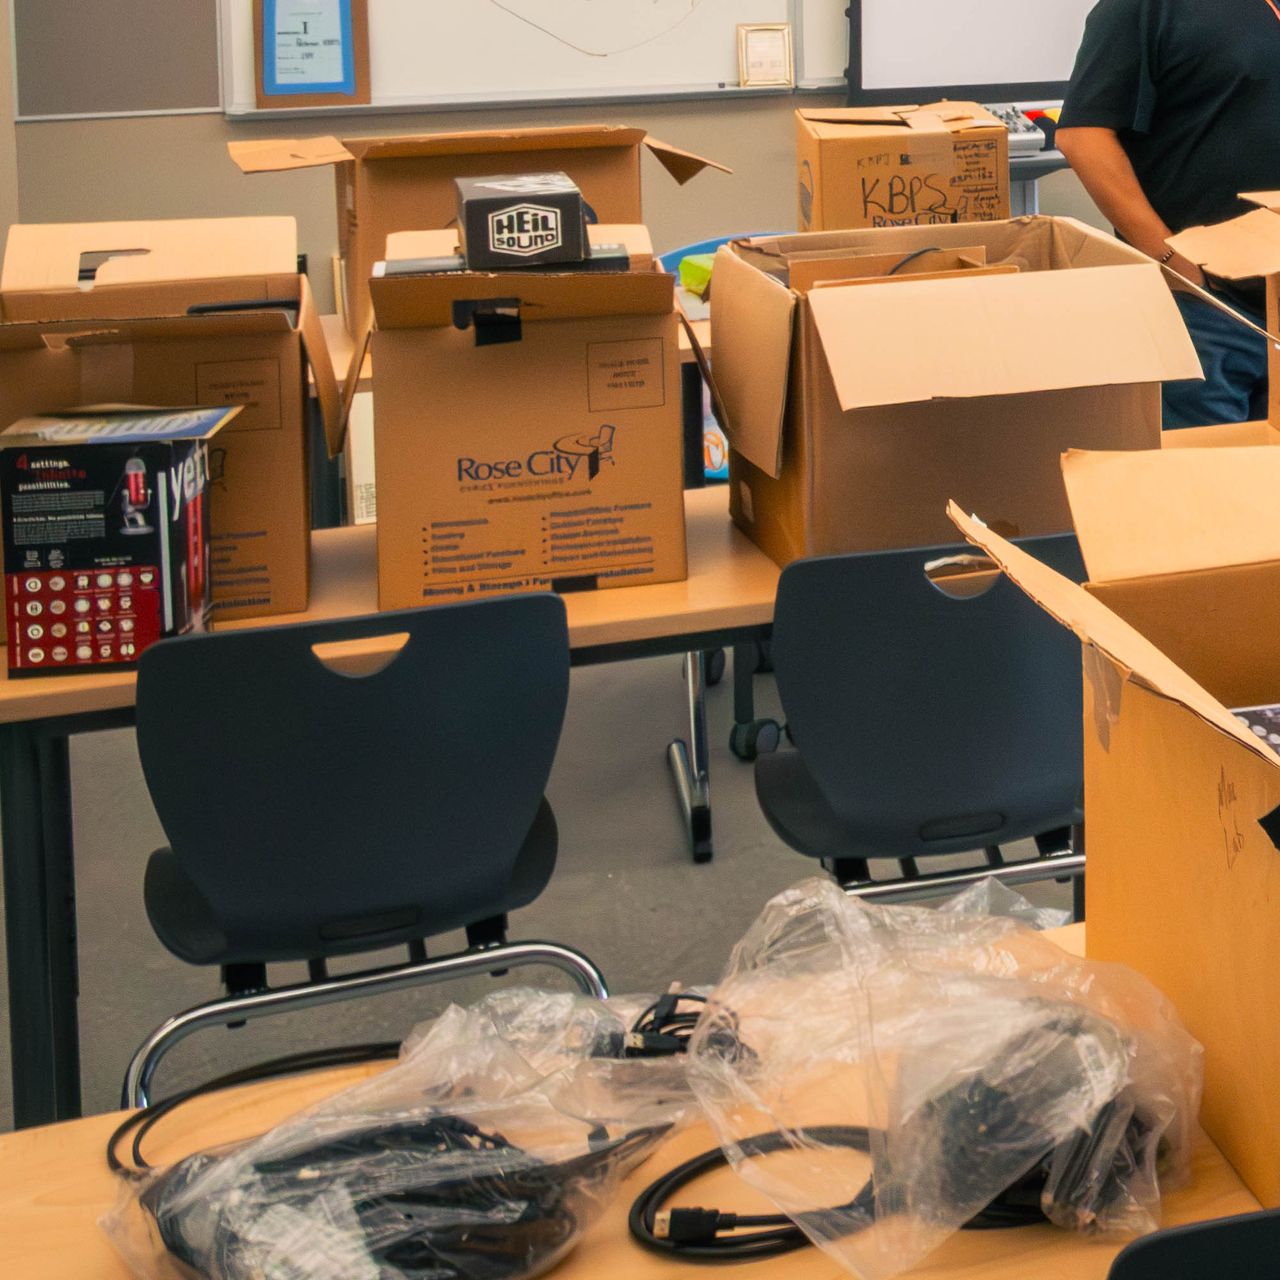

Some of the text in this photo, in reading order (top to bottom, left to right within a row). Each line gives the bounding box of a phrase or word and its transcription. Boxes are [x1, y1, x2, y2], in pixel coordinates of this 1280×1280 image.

[861, 172, 949, 219] KBPS
[16, 454, 28, 469] 4
[457, 450, 582, 481] Rose City
